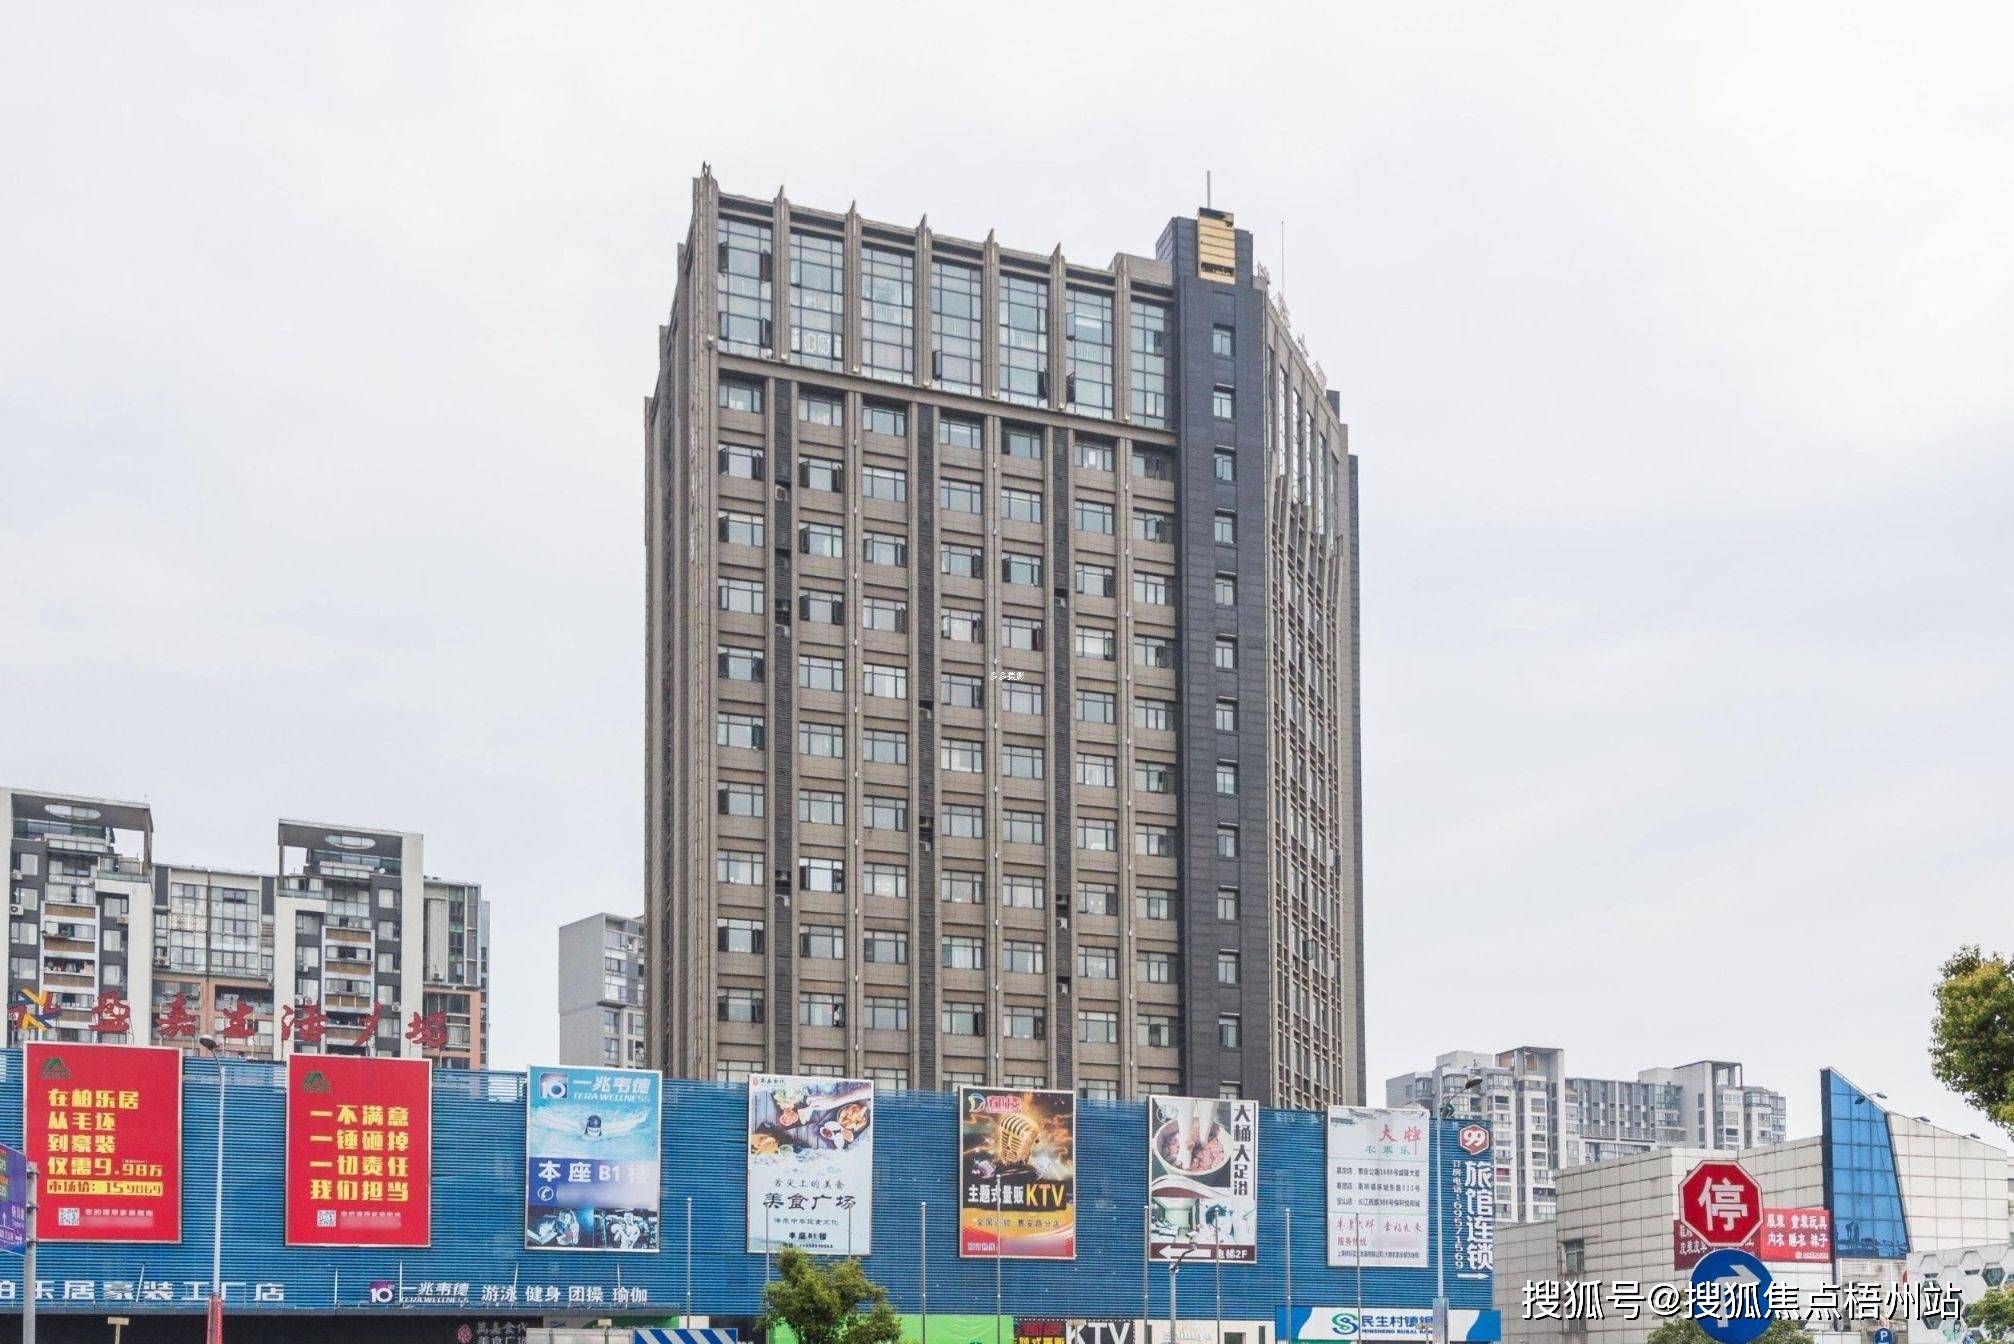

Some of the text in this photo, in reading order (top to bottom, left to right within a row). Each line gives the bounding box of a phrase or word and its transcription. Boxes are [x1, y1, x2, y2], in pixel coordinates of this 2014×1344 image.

[572, 1075, 651, 1094] 一兆韦德
[48, 1088, 139, 1110] 在柏乐居
[573, 1091, 650, 1103] TERA WELLNESS
[48, 1111, 116, 1132] 从毛坯
[310, 1104, 409, 1127] 一不满意
[48, 1133, 116, 1154] 到豪装
[310, 1129, 409, 1152] 一锤砸掉
[1380, 1123, 1421, 1156] 大牌
[1463, 1129, 1486, 1147] 99
[1233, 1104, 1251, 1196] 大桶大足浴
[48, 1157, 163, 1177] 仅需9.98万
[310, 1154, 409, 1178] 一切责任
[310, 1179, 409, 1202] 我们担当
[968, 1183, 1065, 1207] 主题式量贩 KTV
[763, 1192, 856, 1211] 美食广场
[1697, 1176, 1749, 1232] 停
[1464, 1160, 1494, 1271] 旅馆连锁
[1767, 1213, 1786, 1229] 服装
[1767, 1231, 1785, 1247] 内衣
[402, 1282, 470, 1297] 一兆韦德
[482, 1284, 648, 1304] 游泳 健身 团操 瑜伽
[1362, 1314, 1434, 1328] 民生村镇银
